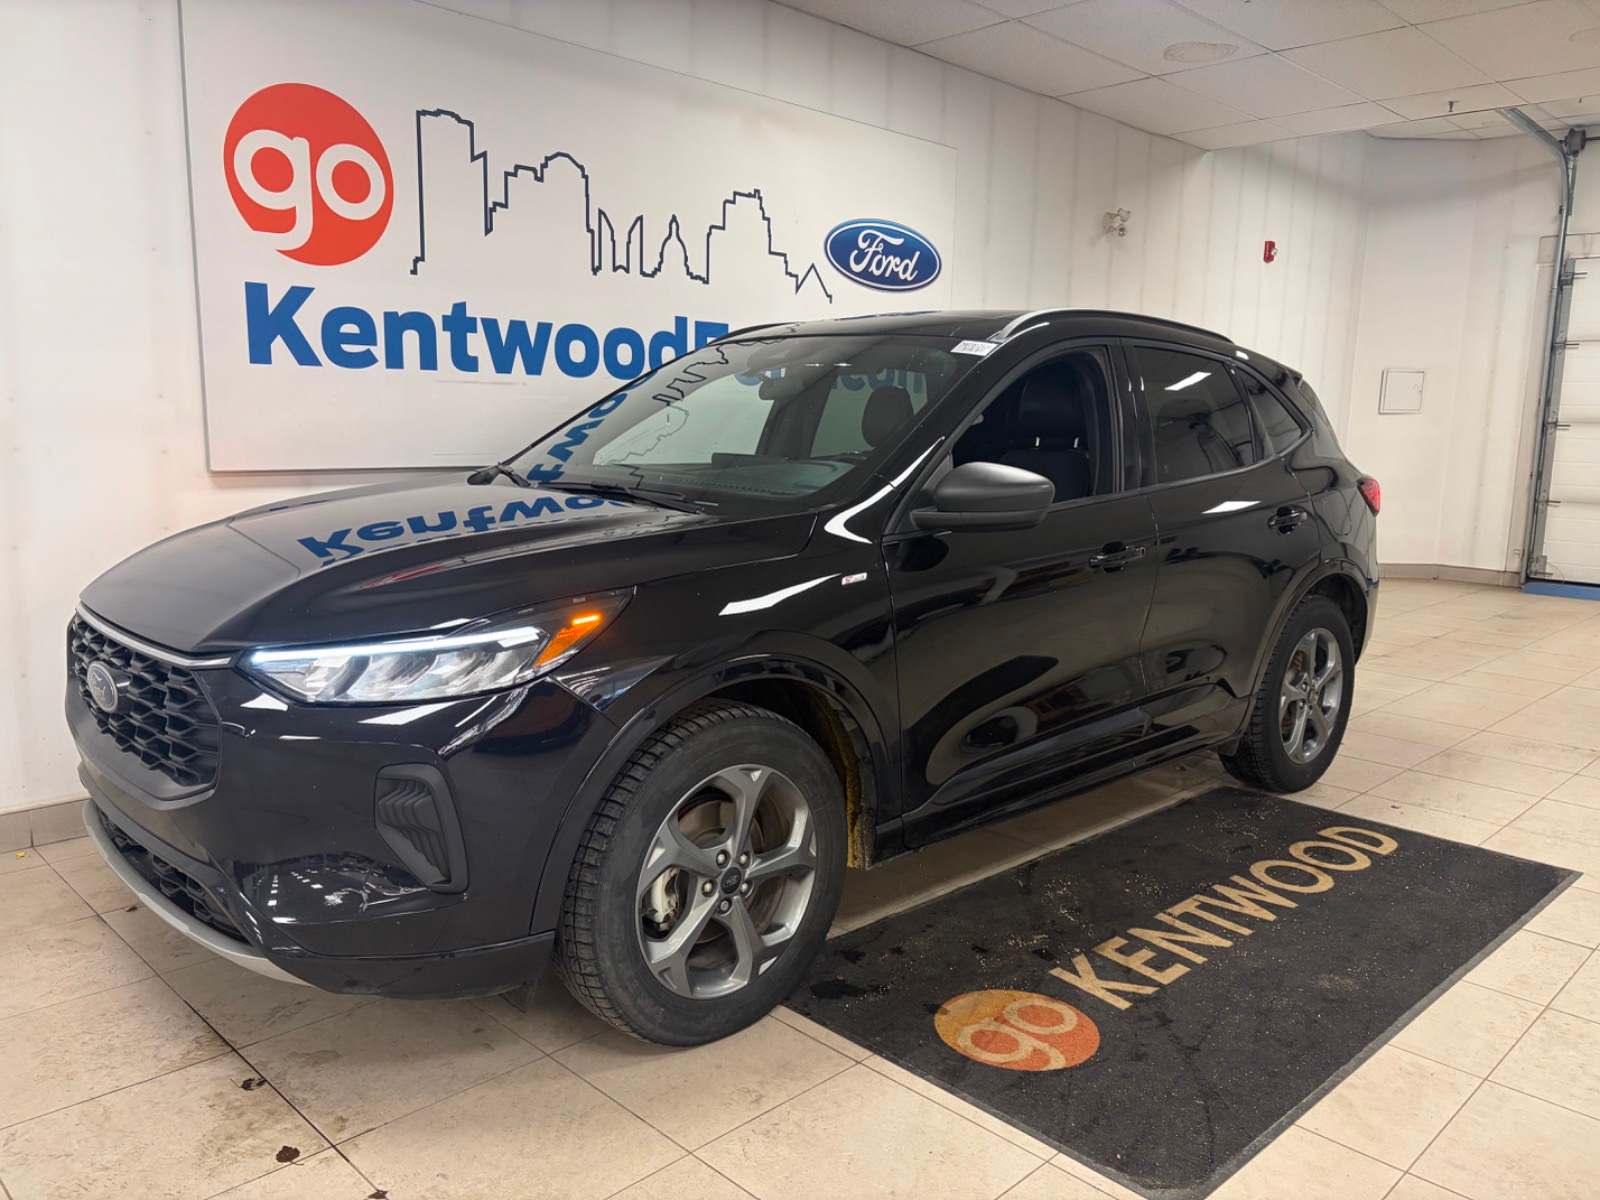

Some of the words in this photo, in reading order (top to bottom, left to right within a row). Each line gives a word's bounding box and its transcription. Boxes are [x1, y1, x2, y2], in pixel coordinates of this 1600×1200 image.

[233, 129, 386, 252] go
[849, 229, 920, 281] Ford
[1049, 826, 1399, 1010] KENTWOOD
